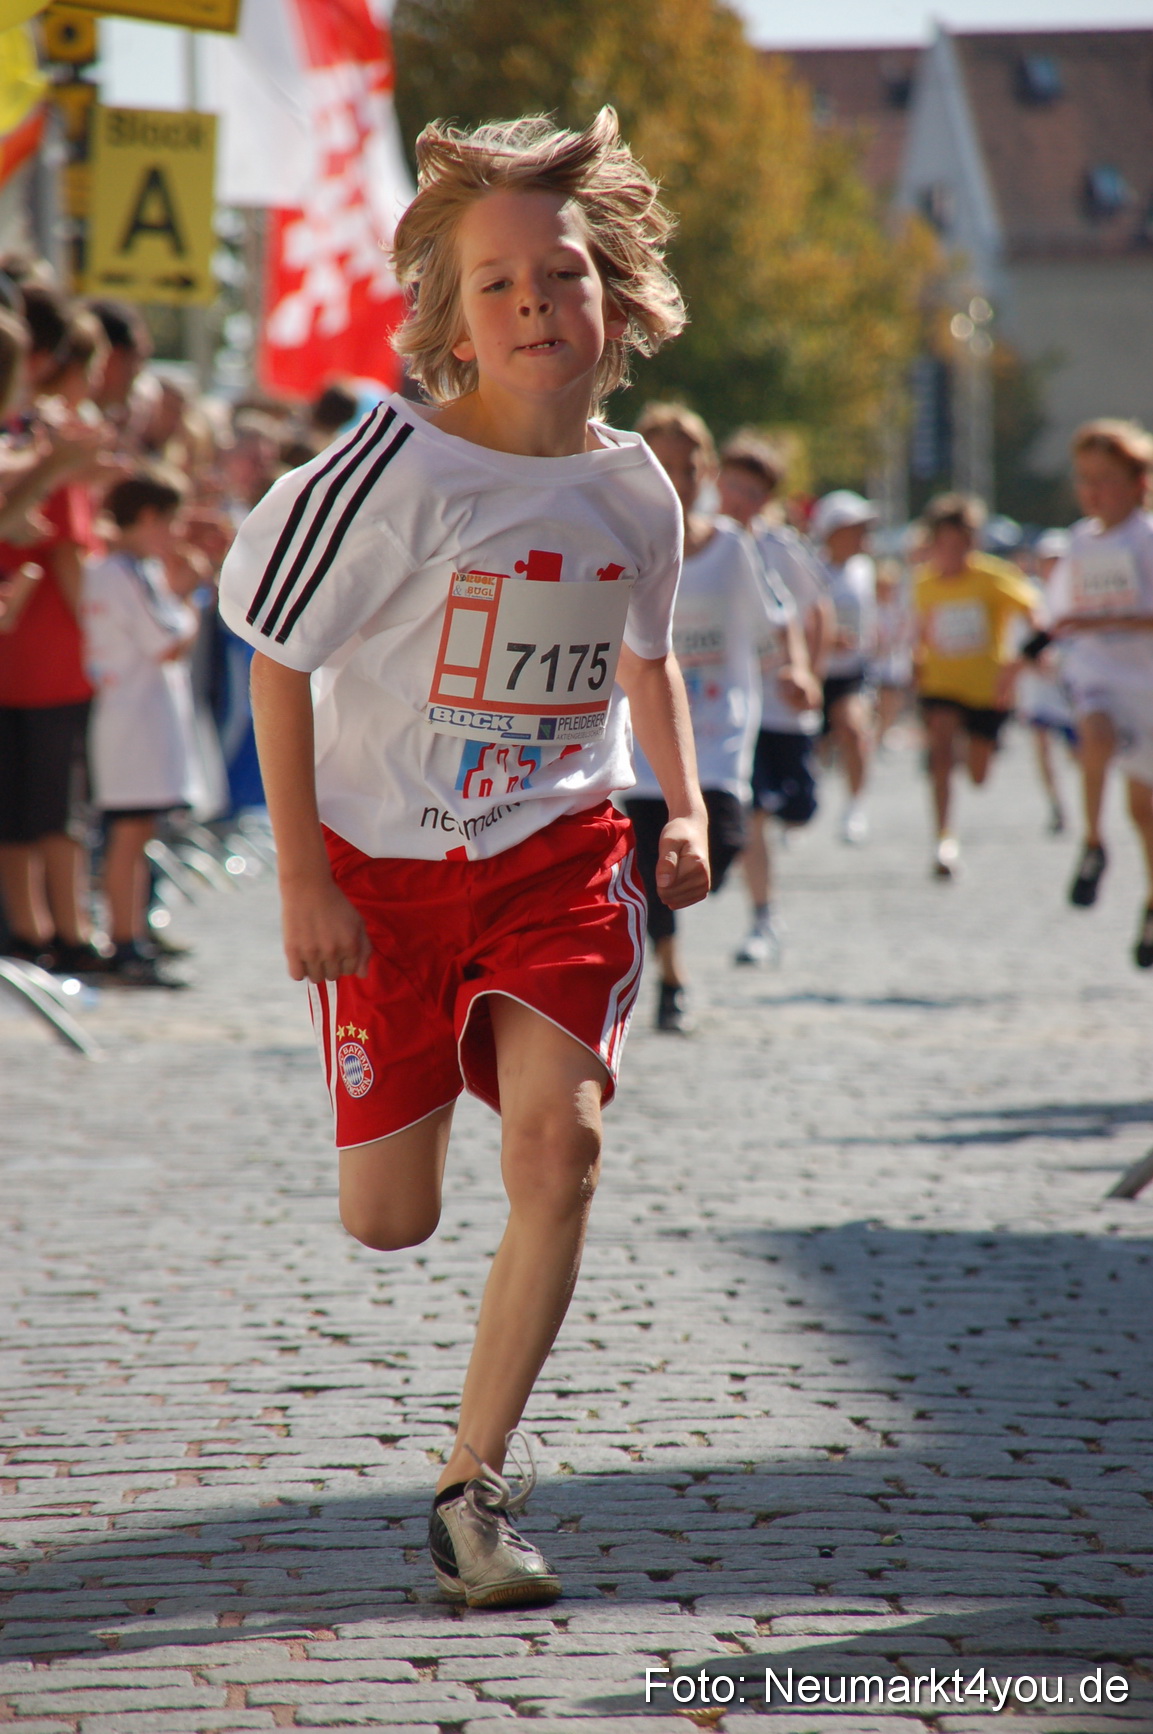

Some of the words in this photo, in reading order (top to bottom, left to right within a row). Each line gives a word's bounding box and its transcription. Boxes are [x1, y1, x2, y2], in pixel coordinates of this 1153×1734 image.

[119, 165, 187, 256] A
[506, 642, 610, 693] 7175
[430, 706, 515, 731] BOCK
